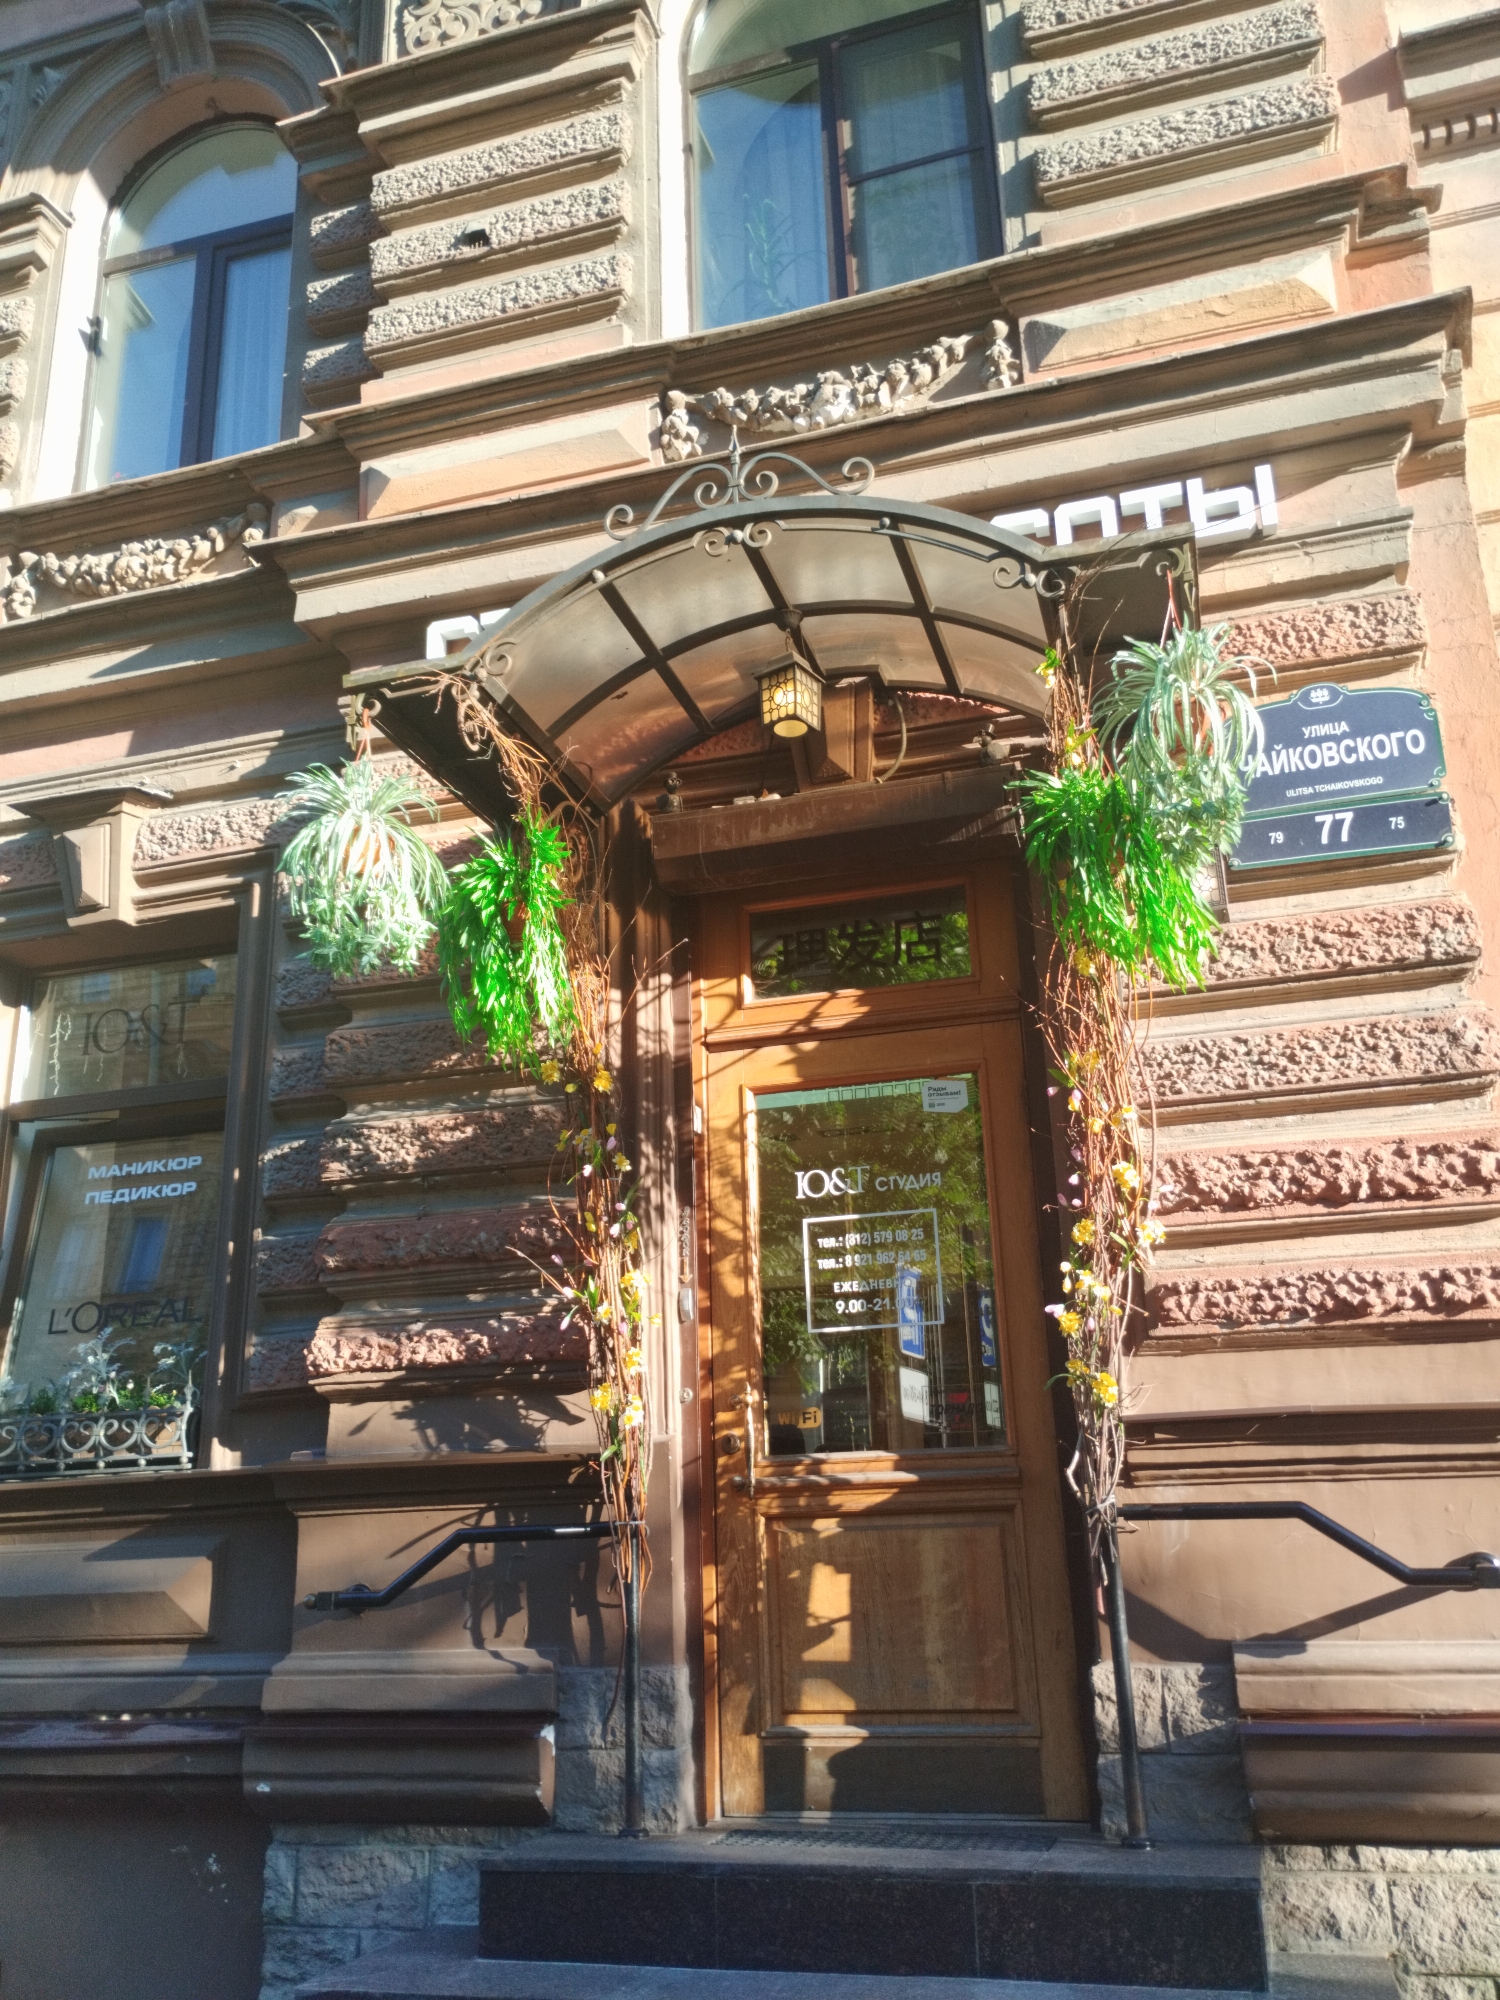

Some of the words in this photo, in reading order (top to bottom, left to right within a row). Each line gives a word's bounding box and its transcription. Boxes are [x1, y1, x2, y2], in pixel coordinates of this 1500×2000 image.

[1302, 721, 1349, 738] УЛИЦА
[1286, 782, 1314, 797] ULITSA
[1315, 776, 1383, 793] TCHAIKOVSKOGO
[1269, 832, 1284, 844] 79
[1315, 812, 1353, 844] 77
[1389, 817, 1405, 829] 75
[88, 1156, 202, 1179] МАНИКЮР
[85, 1182, 197, 1204] ПЕДИКЮР
[817, 1235, 843, 1248] тел.:
[845, 1232, 871, 1249] (812)
[874, 1231, 893, 1244] 579
[896, 1229, 908, 1242] 08
[911, 1228, 924, 1240] 25
[817, 1256, 843, 1270] тел.:
[845, 1254, 852, 1268] 8
[855, 1253, 873, 1267] 921
[876, 1251, 895, 1264] 962
[898, 1250, 911, 1263] 64
[914, 1249, 927, 1261] 65
[833, 1277, 911, 1293] ЕЖЕДНЕВНО
[836, 1297, 914, 1314] 9.00-21.00
